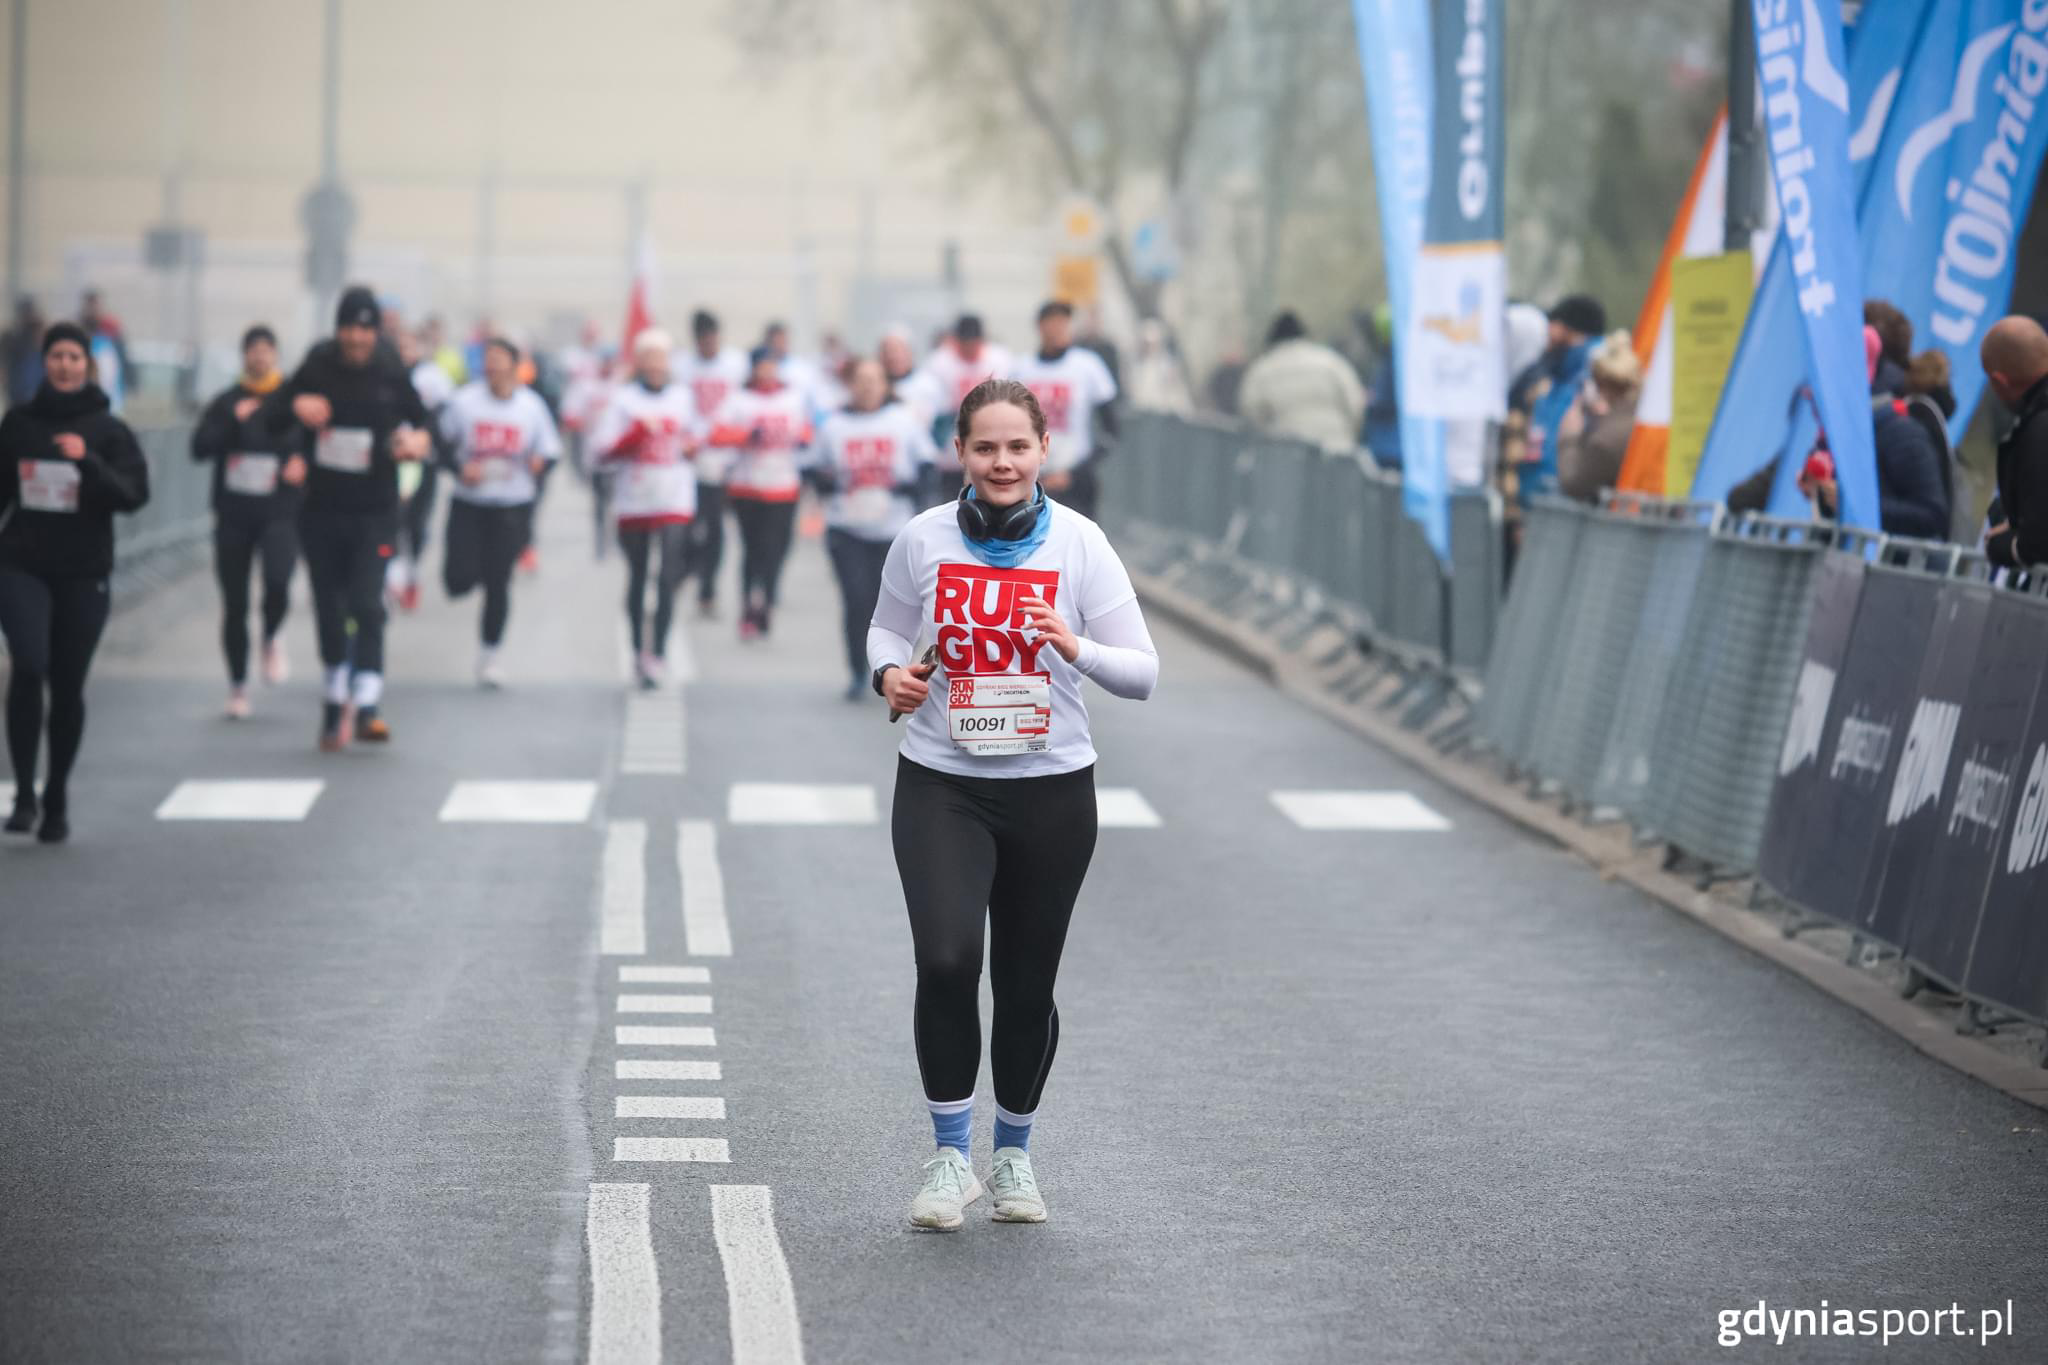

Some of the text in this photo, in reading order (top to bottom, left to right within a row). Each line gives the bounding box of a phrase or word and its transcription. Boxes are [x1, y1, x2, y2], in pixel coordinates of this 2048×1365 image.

[934, 577, 1057, 629] RUN
[938, 625, 1048, 673] GDY
[950, 680, 974, 693] RUN
[949, 693, 974, 704] GDY
[959, 717, 1006, 732] 10091
[977, 742, 1024, 751] gdyniasport.pl
